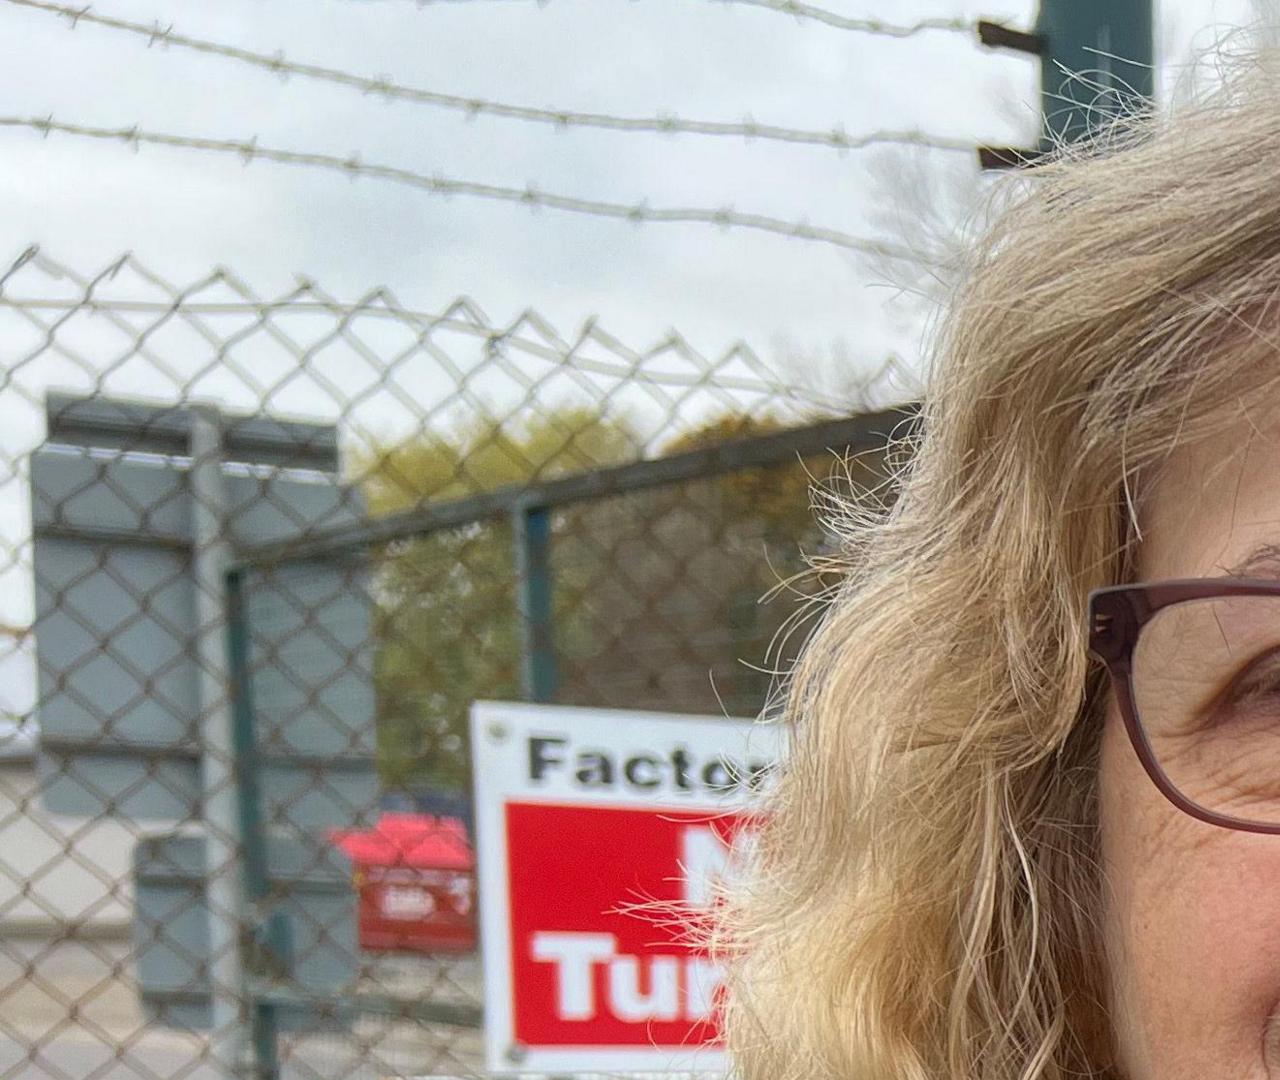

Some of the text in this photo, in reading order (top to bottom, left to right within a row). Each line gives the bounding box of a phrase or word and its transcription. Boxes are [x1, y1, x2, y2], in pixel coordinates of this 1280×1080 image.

[528, 736, 778, 792] Factor
[683, 826, 767, 907] N
[531, 933, 730, 1020] Tur
